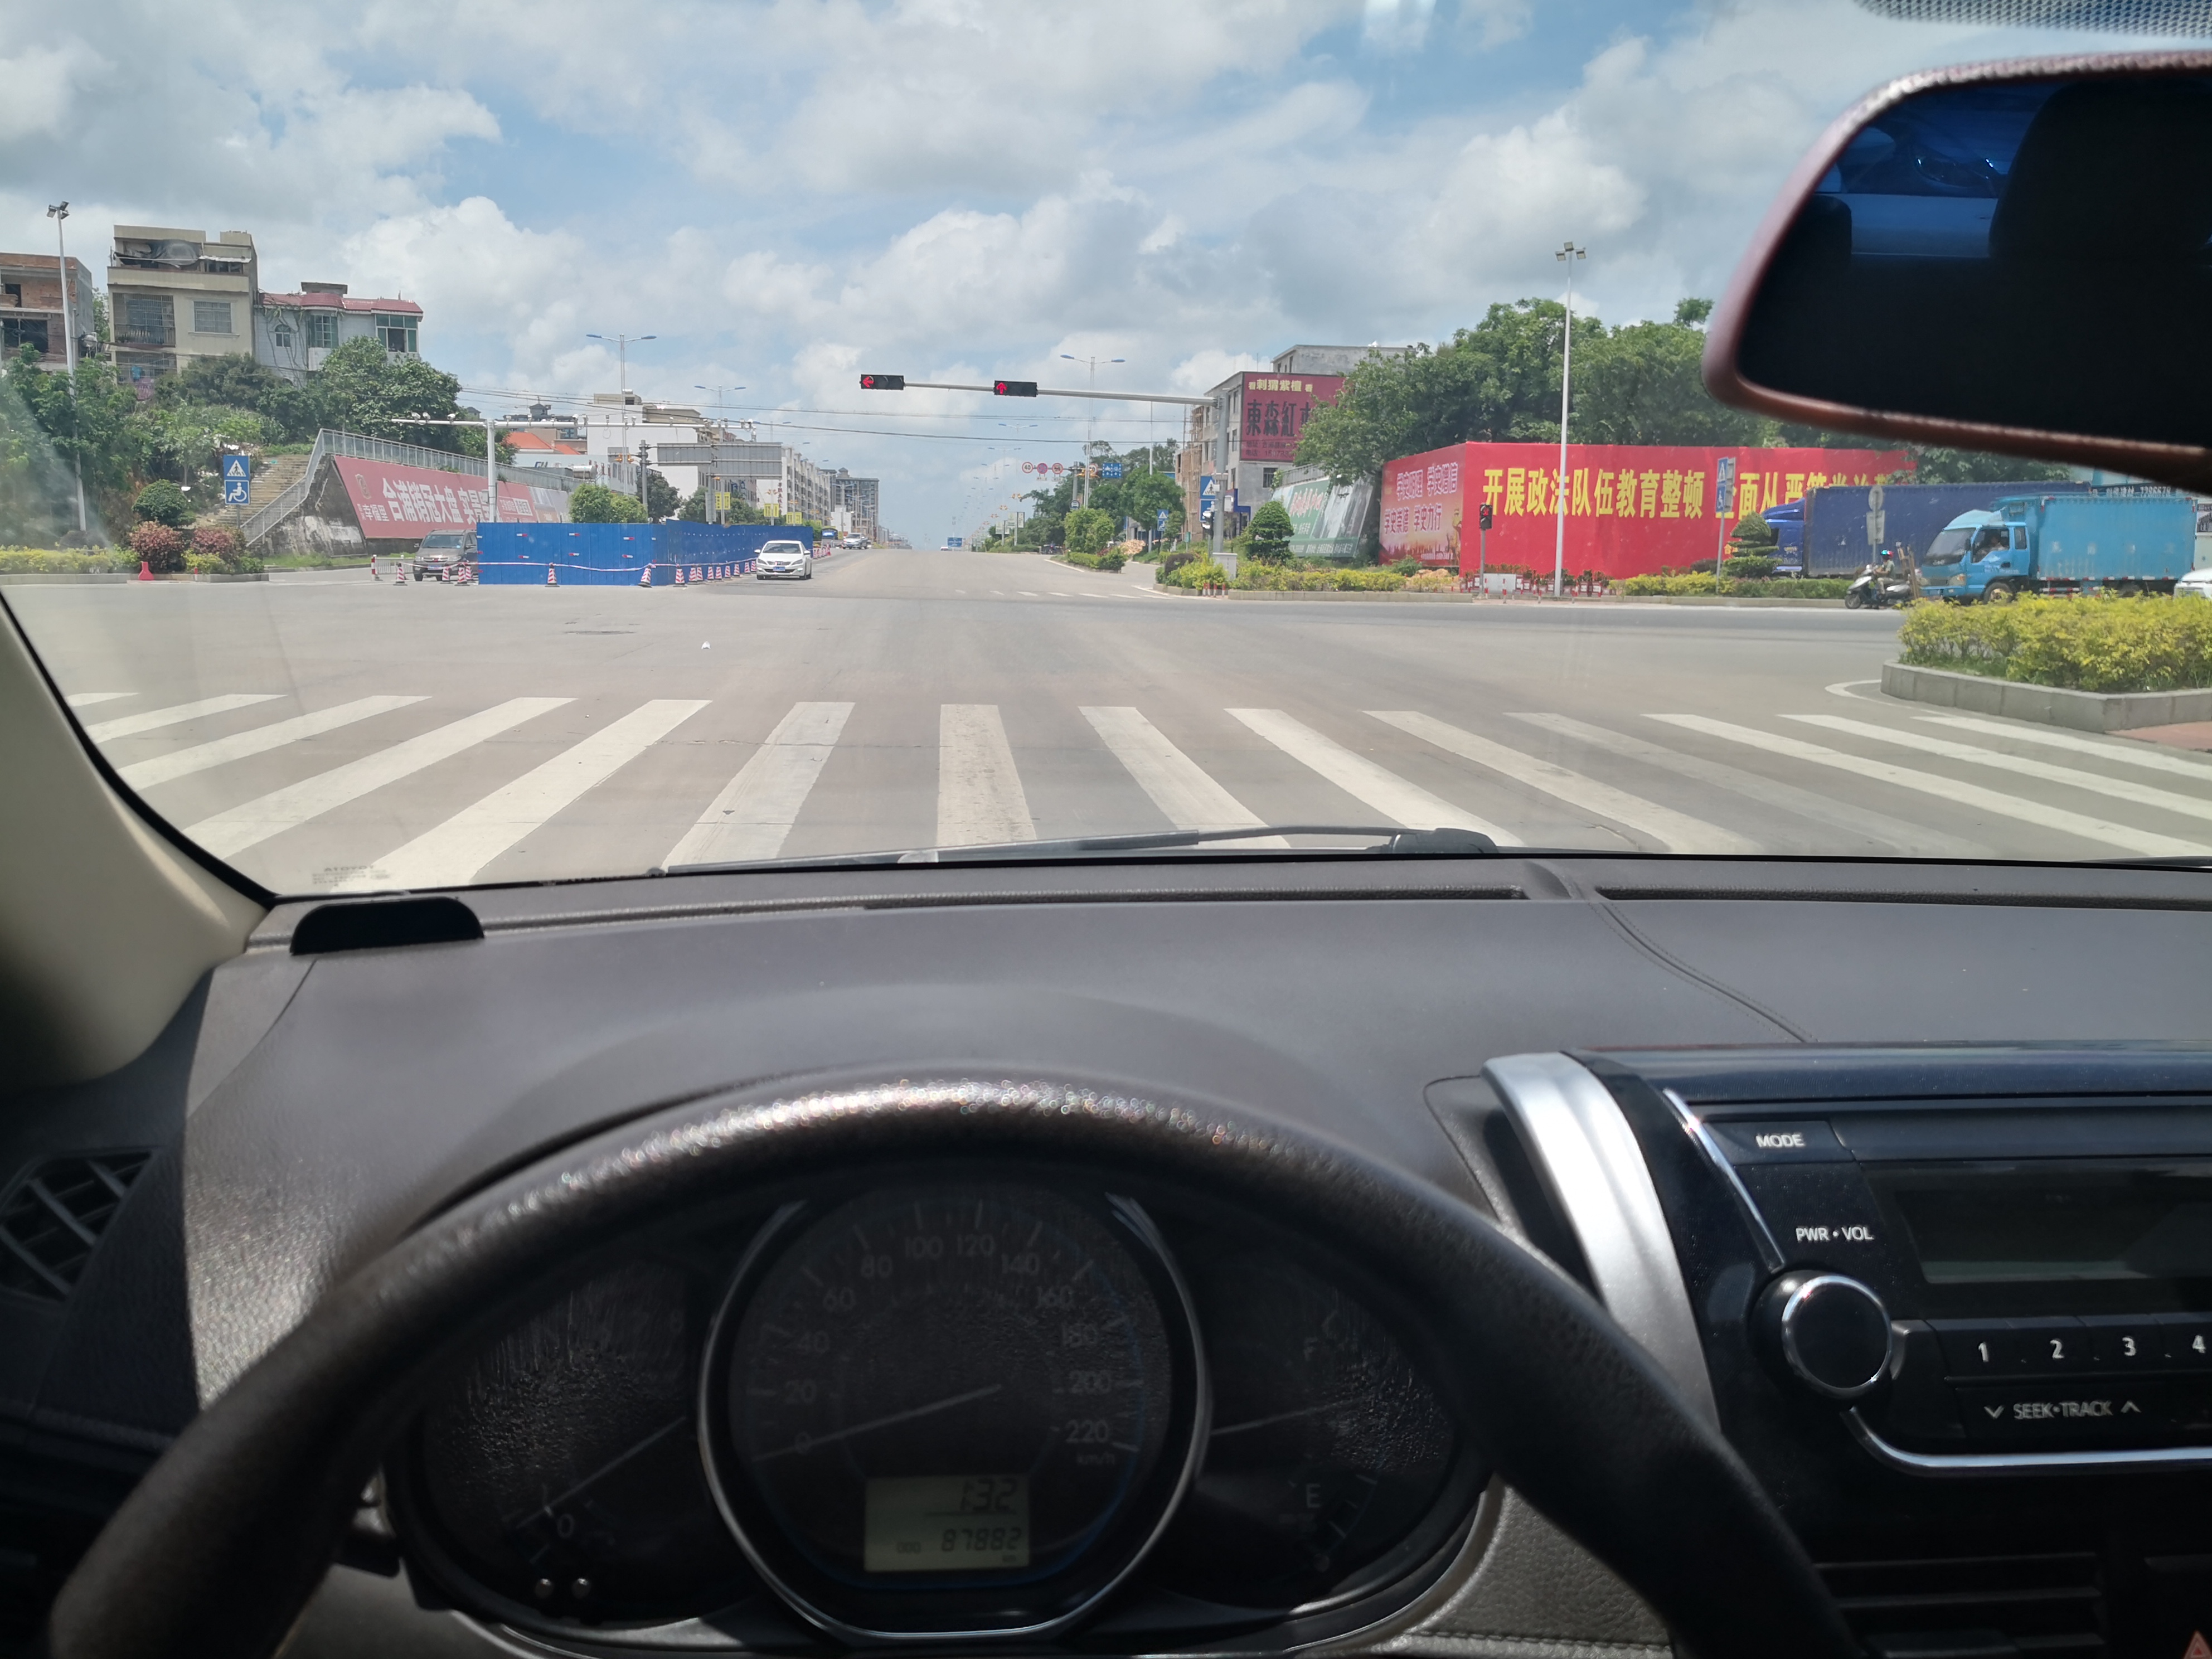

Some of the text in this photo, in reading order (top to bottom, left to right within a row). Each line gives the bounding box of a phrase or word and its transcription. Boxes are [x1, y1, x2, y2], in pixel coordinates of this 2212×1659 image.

[1427, 462, 1458, 497] 学史增信
[382, 477, 464, 523] 合浦销冠大盘
[1482, 467, 1705, 519] 开展政法队伍教育整顿
[1384, 502, 1443, 535] 学史崇德 学史力行
[1755, 1133, 1805, 1148] MODE
[955, 1234, 995, 1257] 120
[1796, 1226, 1875, 1243] PWR VOL
[904, 1236, 942, 1260] 100
[861, 1255, 892, 1278] 80
[1003, 1253, 1041, 1276] 140
[823, 1288, 856, 1312] 60
[1036, 1286, 1074, 1309] 160
[797, 1331, 830, 1355] 40
[1061, 1322, 1099, 1347] 180
[2122, 1336, 2137, 1357] 3
[2192, 1335, 2206, 1354] 4
[1978, 1341, 1990, 1362] 1
[2049, 1338, 2064, 1359] 2
[784, 1380, 816, 1404] 20
[1069, 1370, 1112, 1394] 200
[1065, 1420, 1109, 1443] 220
[1076, 1451, 1115, 1466] km/h
[961, 1477, 1017, 1512] 132
[1306, 1483, 1322, 1508] E
[941, 1527, 1022, 1552] 87882
